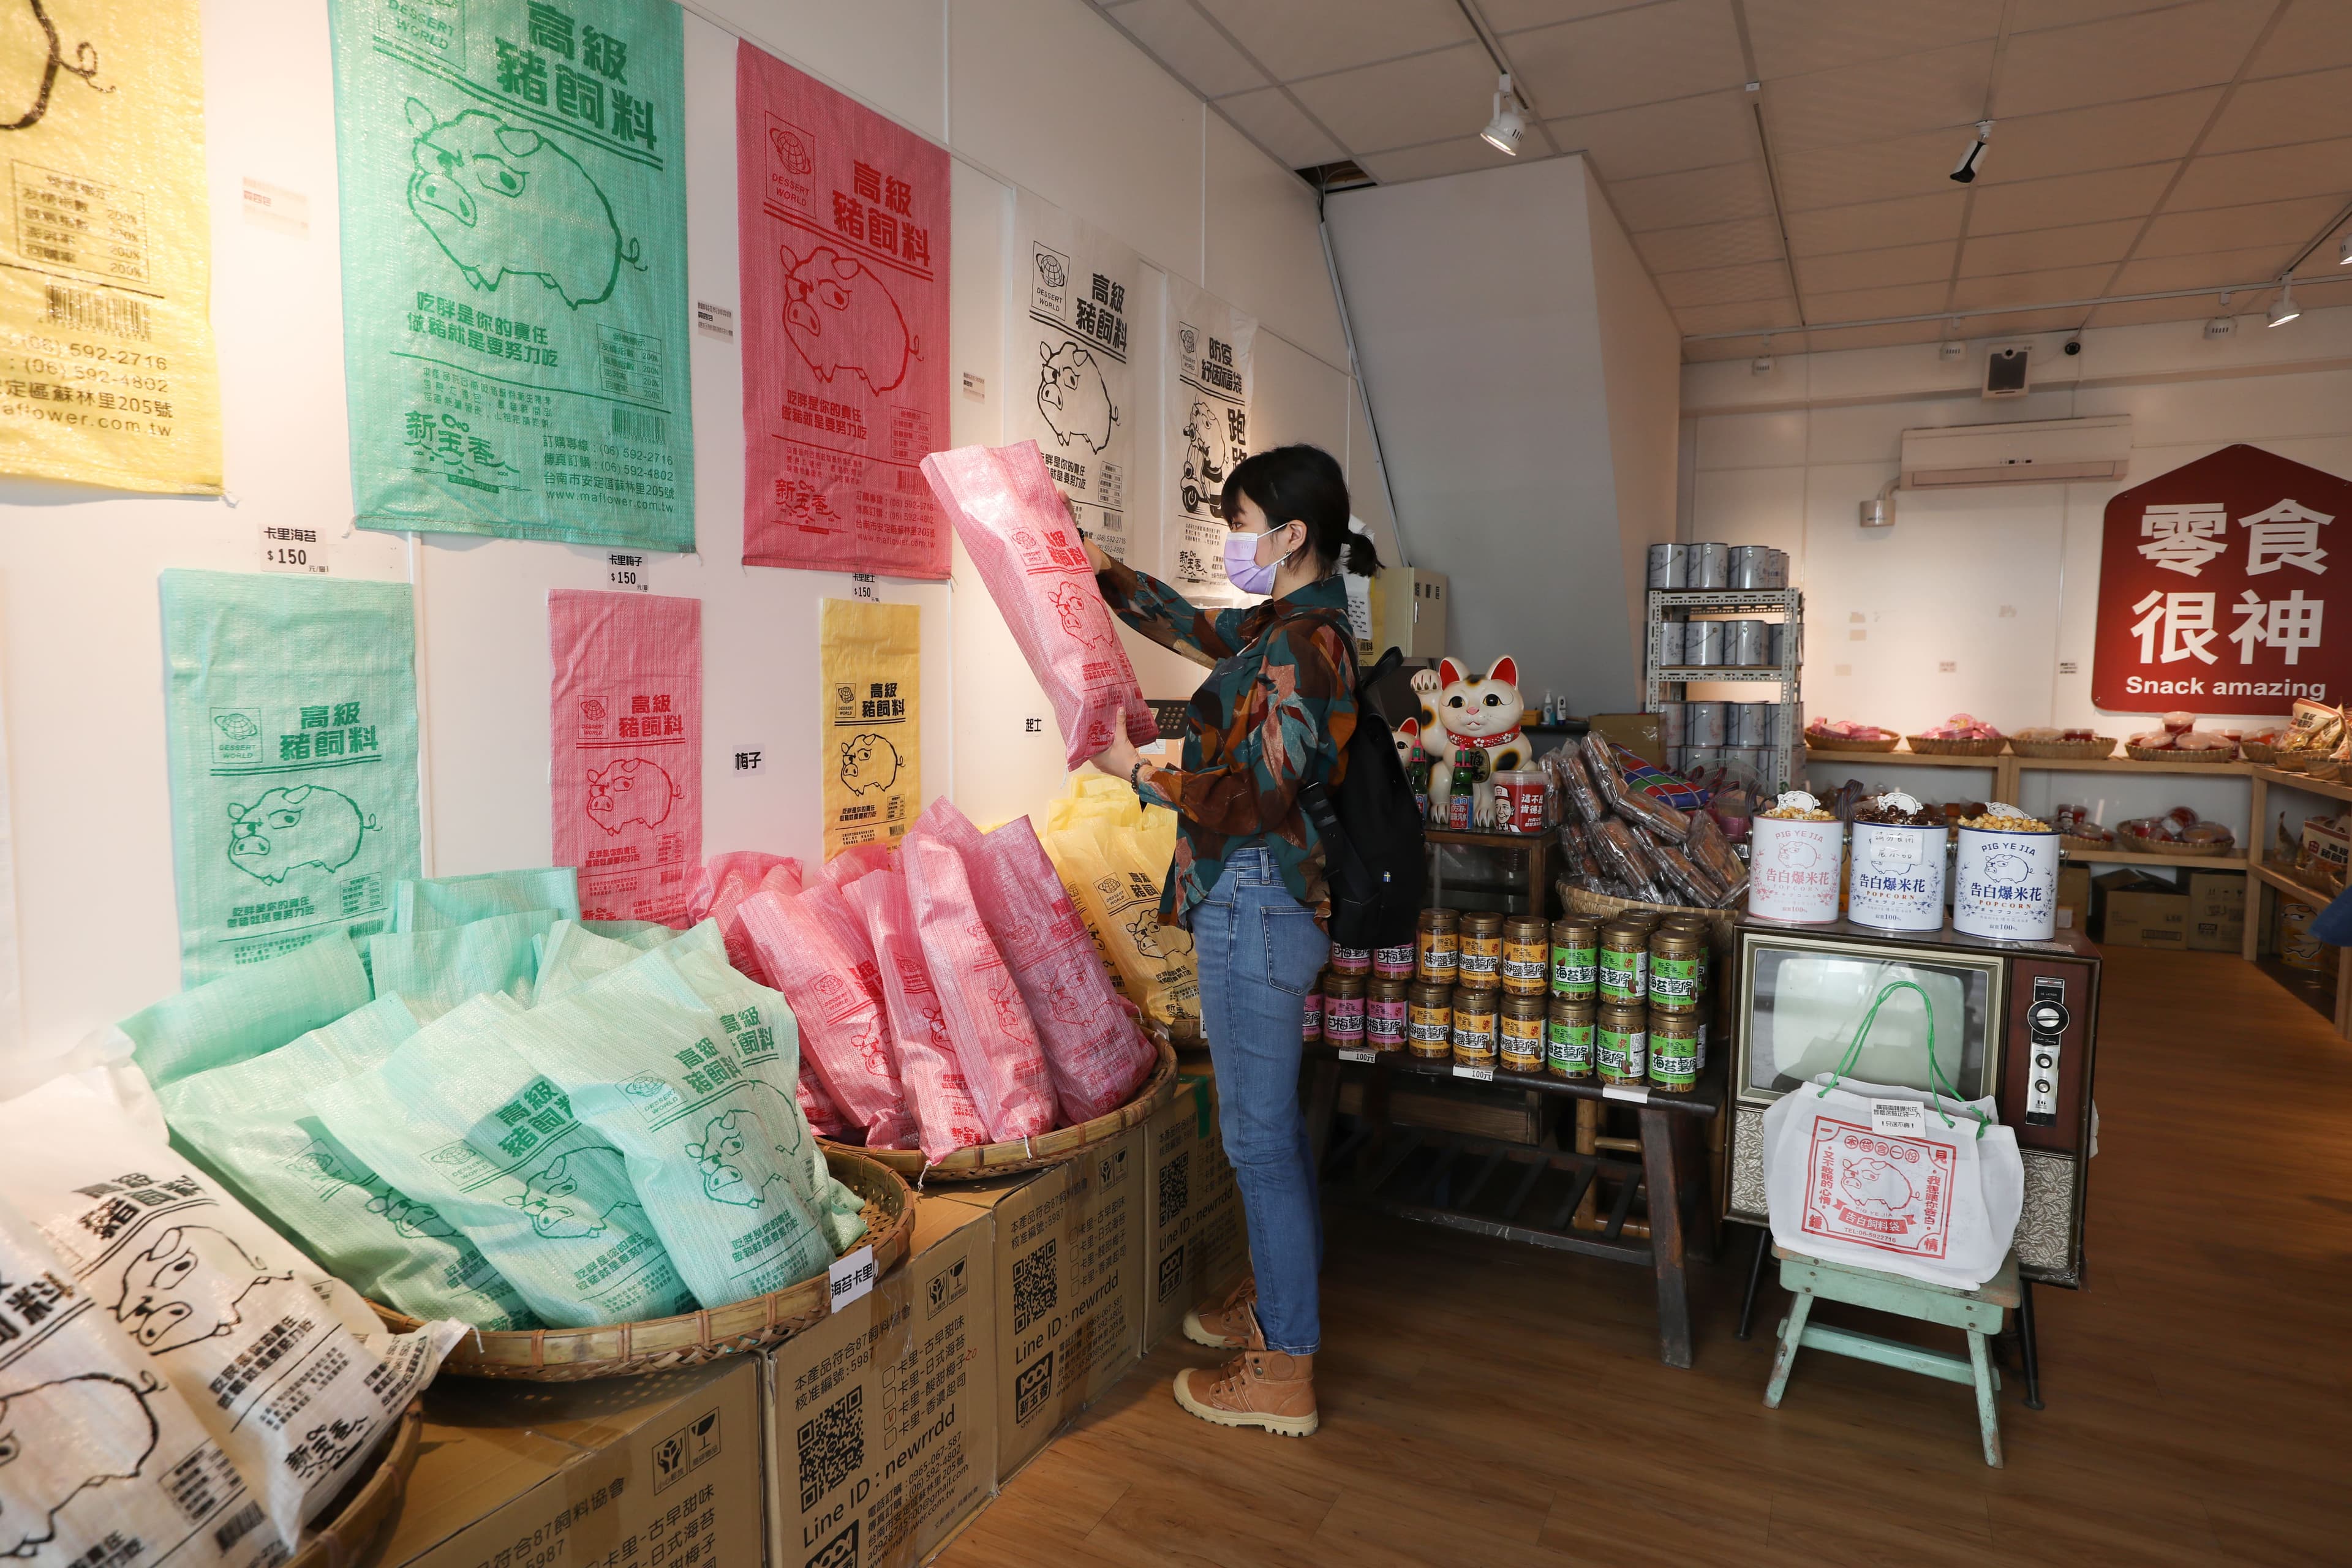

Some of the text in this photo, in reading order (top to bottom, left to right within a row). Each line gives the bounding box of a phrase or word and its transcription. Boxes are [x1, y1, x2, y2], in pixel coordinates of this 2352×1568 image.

[397, 17, 449, 50] WORLD
[526, 0, 627, 85] 高級
[495, 37, 657, 151] 豬飼料
[772, 173, 810, 197] DESSERT
[776, 187, 807, 207] WORLD
[853, 159, 913, 219] 高級
[832, 189, 930, 268] 豬飼料
[1036, 287, 1063, 304] DESSERT
[1039, 298, 1060, 312] WORLD
[1091, 273, 1125, 315] 高級
[1076, 297, 1127, 352] 豬飼料
[70, 342, 168, 371] 592-2716
[1209, 336, 1234, 368] 防疫
[1201, 358, 1243, 395] 紓困福袋
[0, 378, 174, 419] 定區蘇林里205號
[622, 447, 673, 466] 592-2716
[1040, 452, 1085, 477] 胖是你的責任
[624, 464, 674, 482] 592-4802
[545, 488, 674, 514] www.maflower.com.tw
[264, 527, 317, 543] 卡里海苔
[2136, 497, 2336, 578] 零食
[609, 554, 643, 567] 卡里梅子
[2129, 589, 2325, 666] 很神
[870, 682, 898, 699] 高級
[2125, 675, 2328, 702] Snack amazing
[300, 701, 360, 729] 高級
[631, 694, 671, 714] 高級
[862, 698, 905, 718] 豬飼料
[619, 714, 684, 738] 豬飼料
[1025, 718, 1042, 733] 起士
[279, 725, 379, 761] 豬飼料
[735, 751, 762, 771] 梅子
[1775, 831, 1792, 839] PIG
[1808, 832, 1824, 843] JIA
[1981, 842, 1999, 853] PIG
[2020, 844, 2036, 856] JIA
[1766, 867, 1830, 886] 告白爆米花
[1859, 873, 1926, 893] 告白爆米花
[1866, 891, 1915, 900] POPCORN
[1970, 882, 2043, 902] 告白爆米花
[1979, 899, 2032, 910] POPCORN
[676, 1036, 721, 1070] 高級
[1355, 1053, 1374, 1063] 100元
[682, 1054, 743, 1095] 豬飼料
[1471, 1070, 1492, 1081] 100元
[497, 1080, 559, 1126] 高級
[652, 1096, 679, 1114] WORLD
[1159, 1183, 1234, 1254] Line newrrdd
[1845, 1211, 1901, 1232] 告白飼料袋
[1843, 1226, 1897, 1244] TEL:06-5922716
[1924, 1237, 1939, 1253] 情
[831, 1262, 875, 1300] 海苔卡里
[1016, 1333, 1044, 1365] Line
[1071, 1268, 1119, 1322] newrrdd
[897, 1314, 965, 1375] 卡里-古早甜味
[897, 1333, 966, 1395] 卡里-日式海苔
[898, 1352, 966, 1416] 卡里-酸甜梅子
[899, 1372, 966, 1436] 卡里-香濃起司
[803, 1502, 845, 1549] Line
[886, 1403, 956, 1479] newrrdd
[925, 1444, 962, 1483] 592-4802
